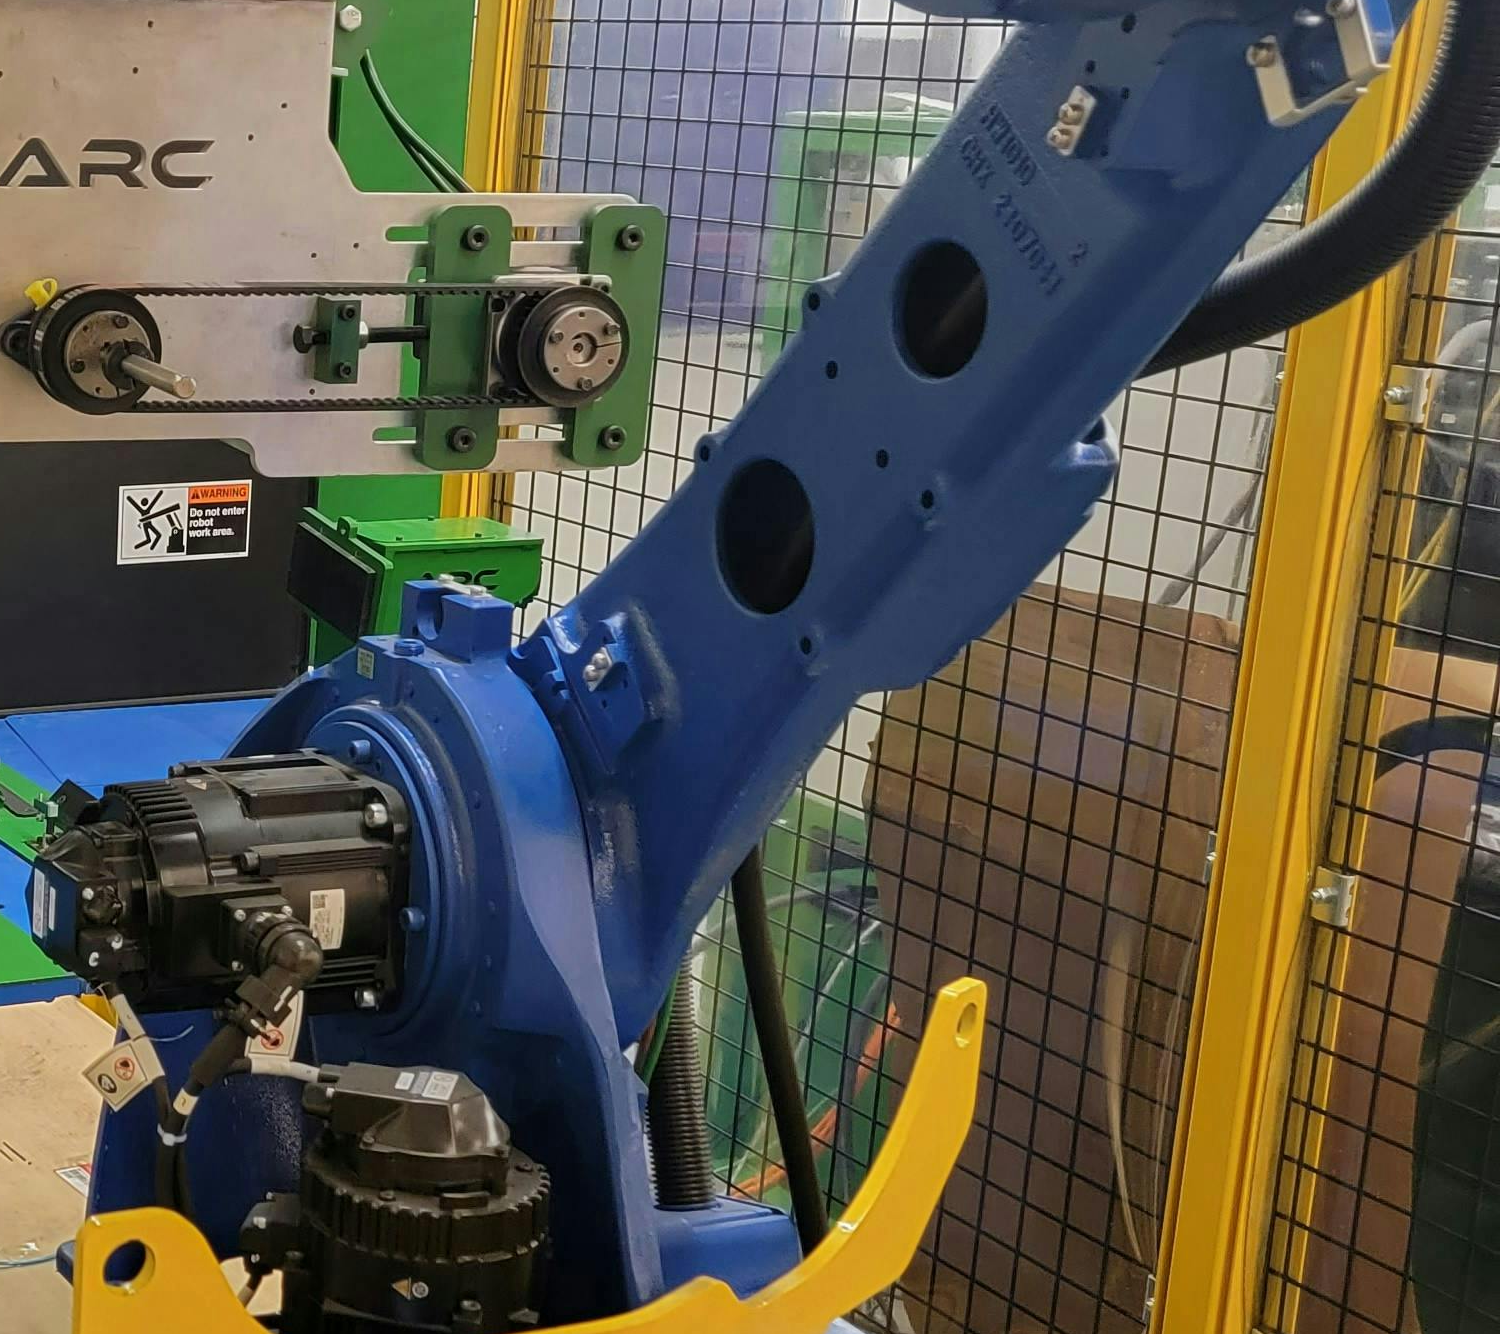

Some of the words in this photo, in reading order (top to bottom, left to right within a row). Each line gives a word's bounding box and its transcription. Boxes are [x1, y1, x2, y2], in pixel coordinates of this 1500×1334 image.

[200, 487, 247, 499] WARNING
[190, 507, 202, 517] Do
[205, 507, 220, 516] not
[222, 506, 246, 516] enter
[189, 518, 214, 527] robot
[189, 528, 211, 538] work
